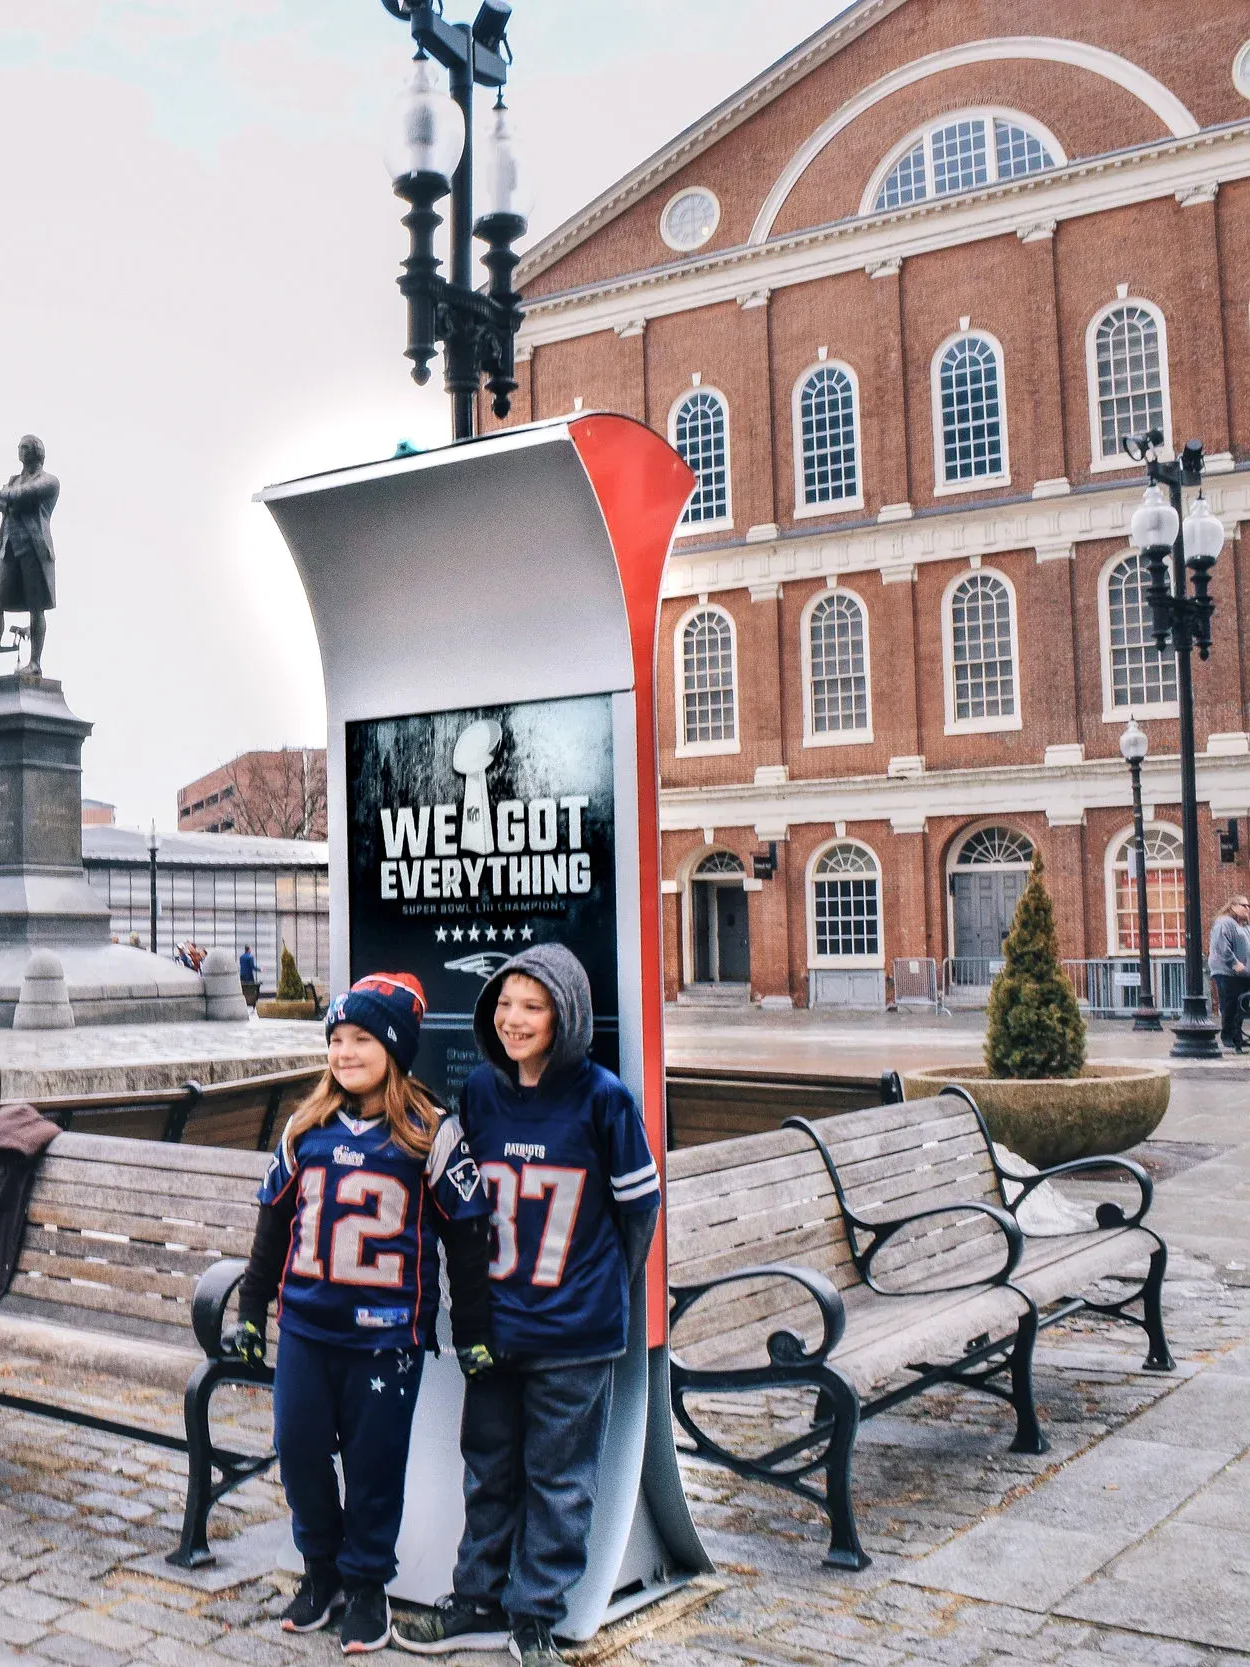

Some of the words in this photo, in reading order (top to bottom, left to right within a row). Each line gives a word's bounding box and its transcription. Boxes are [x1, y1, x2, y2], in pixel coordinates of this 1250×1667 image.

[380, 804, 458, 858] WE
[496, 795, 589, 853] GOT
[380, 853, 591, 899] EVERYTHING
[402, 903, 437, 915] SUPER
[441, 902, 472, 914] BOWL
[498, 901, 566, 913] CHAMPIONS
[446, 1048, 475, 1060] Share
[504, 1142, 546, 1159] PATRIOTS
[291, 1166, 410, 1287] 12
[479, 1161, 587, 1287] 87
